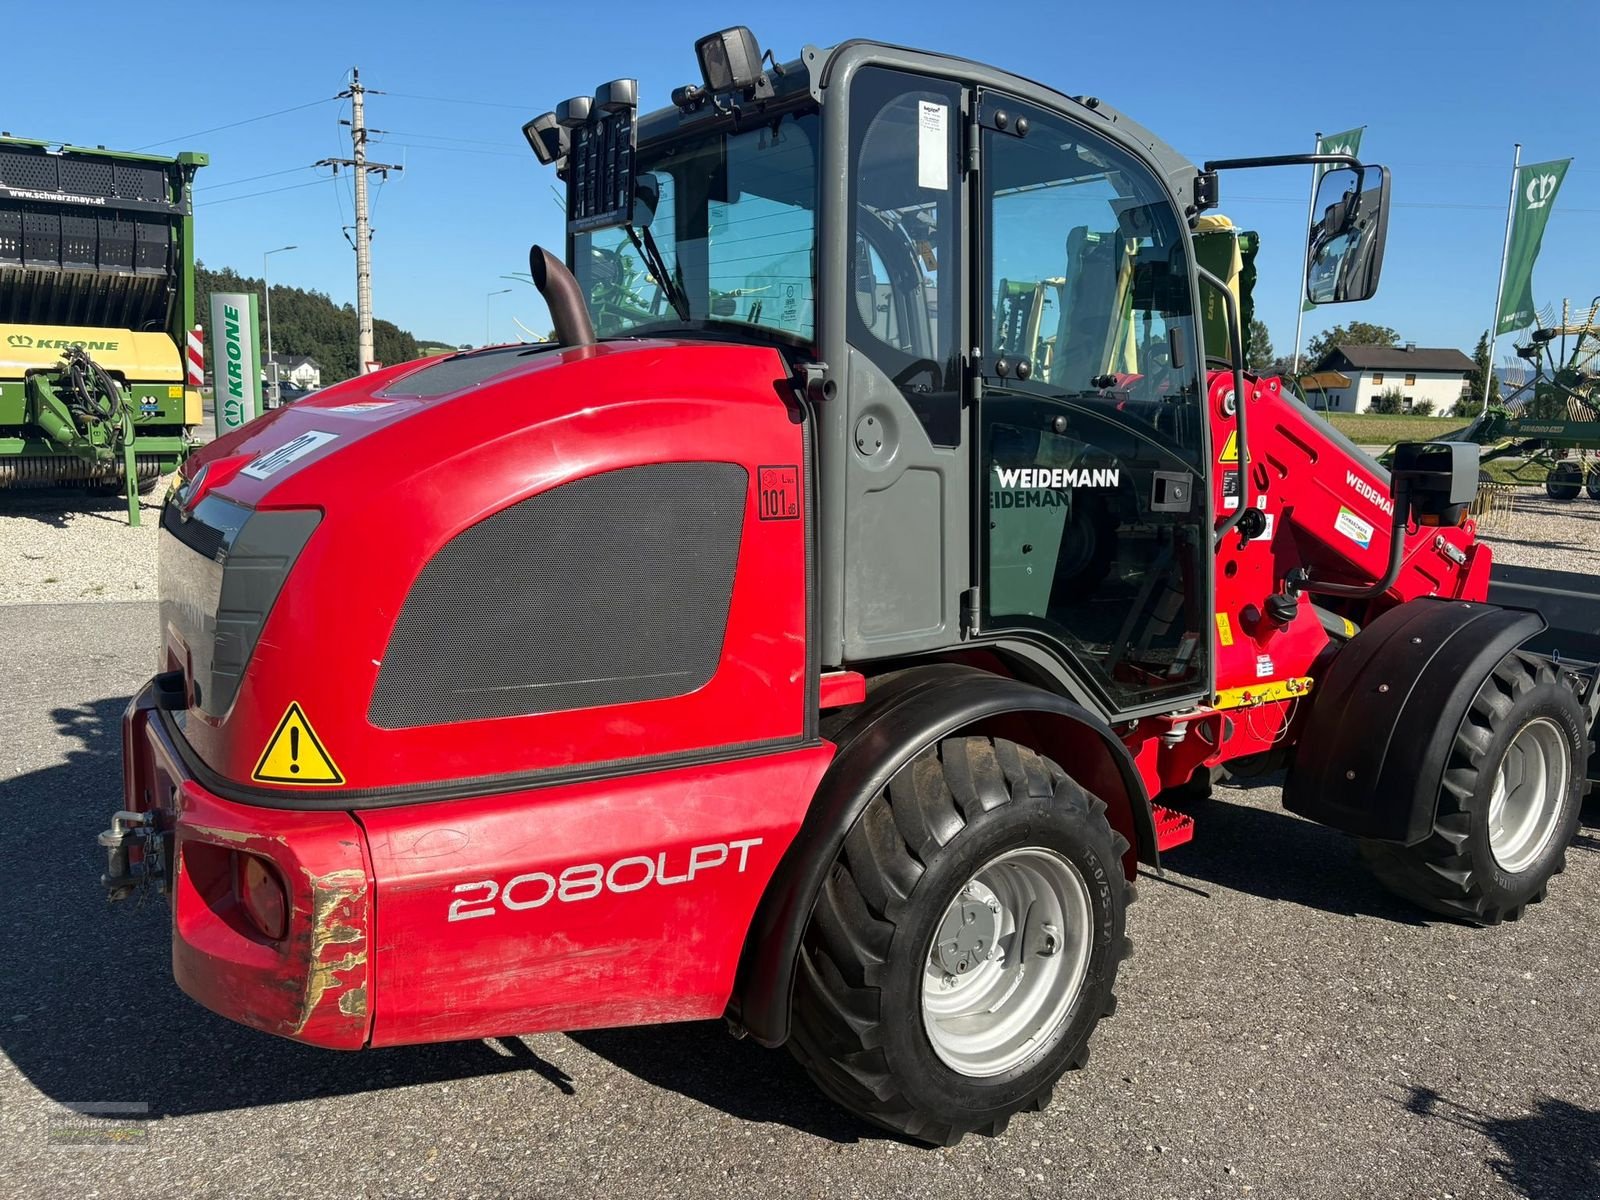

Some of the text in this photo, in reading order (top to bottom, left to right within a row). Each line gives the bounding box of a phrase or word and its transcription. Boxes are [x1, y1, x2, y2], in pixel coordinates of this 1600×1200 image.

[9, 190, 105, 205] www.schwarzmayr.at
[36, 339, 119, 351] KRONE
[223, 303, 244, 399] KRONE
[996, 468, 1119, 489] WEIDEMANN
[763, 489, 786, 516] 101
[448, 837, 764, 922] 2080LPT
